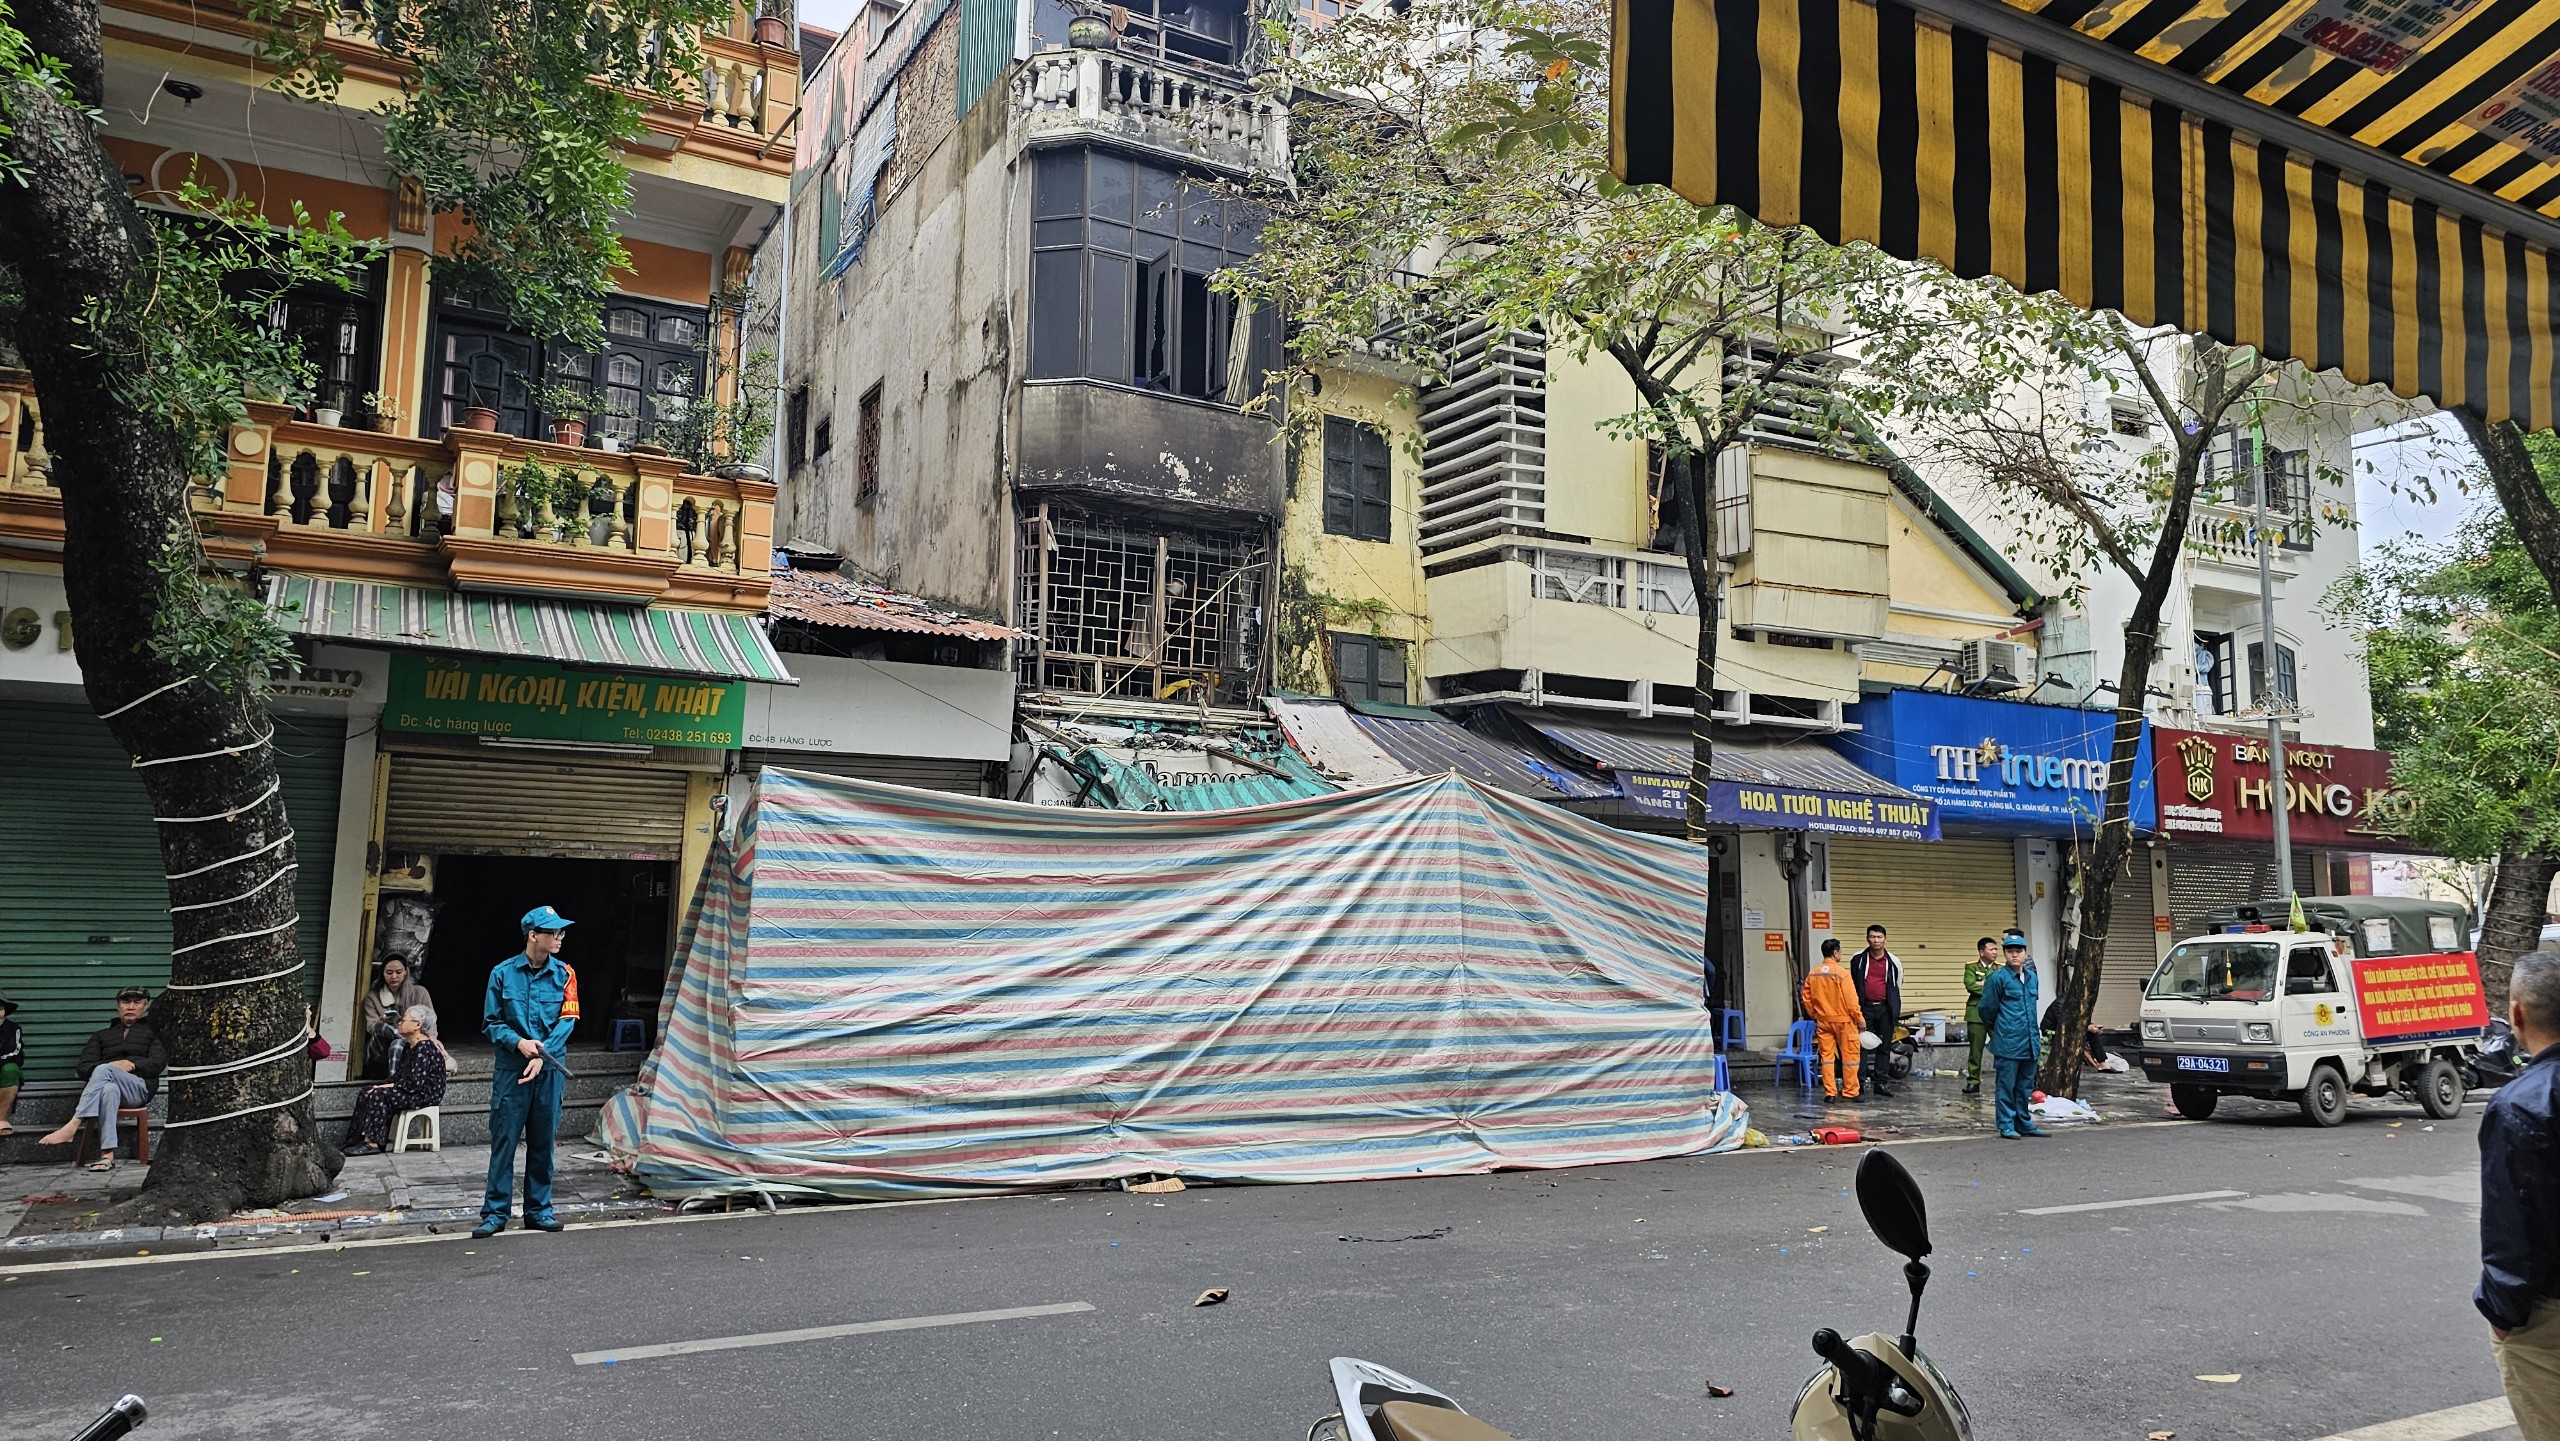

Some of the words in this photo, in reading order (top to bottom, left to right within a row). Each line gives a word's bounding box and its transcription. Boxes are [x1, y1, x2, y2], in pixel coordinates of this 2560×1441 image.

[425, 660, 471, 699] VẢI
[478, 673, 568, 715] NGOẠI,
[577, 675, 648, 718] KIỆN,
[654, 681, 725, 722] NHẬT
[400, 714, 422, 727] Đc.
[425, 716, 441, 728] 4c
[447, 717, 479, 734] hàng
[484, 719, 512, 735] lược
[623, 727, 644, 739] Tel:
[646, 728, 682, 741] 02438
[686, 731, 706, 743] 251
[709, 732, 732, 744] 693
[780, 735, 805, 745] HÀNG
[1930, 744, 1980, 782] TH
[2289, 750, 2335, 774] NGỌT
[1912, 784, 1929, 793] CÔNG
[2191, 777, 2209, 793] HK
[1662, 789, 1681, 799] 2B
[1739, 789, 1777, 813] HOA
[1781, 794, 1823, 817] TƯƠI
[1827, 799, 1874, 825] NGHỆ
[1878, 803, 1930, 828] THUẬT
[1808, 822, 1857, 833] HOTLINE/ZALO:
